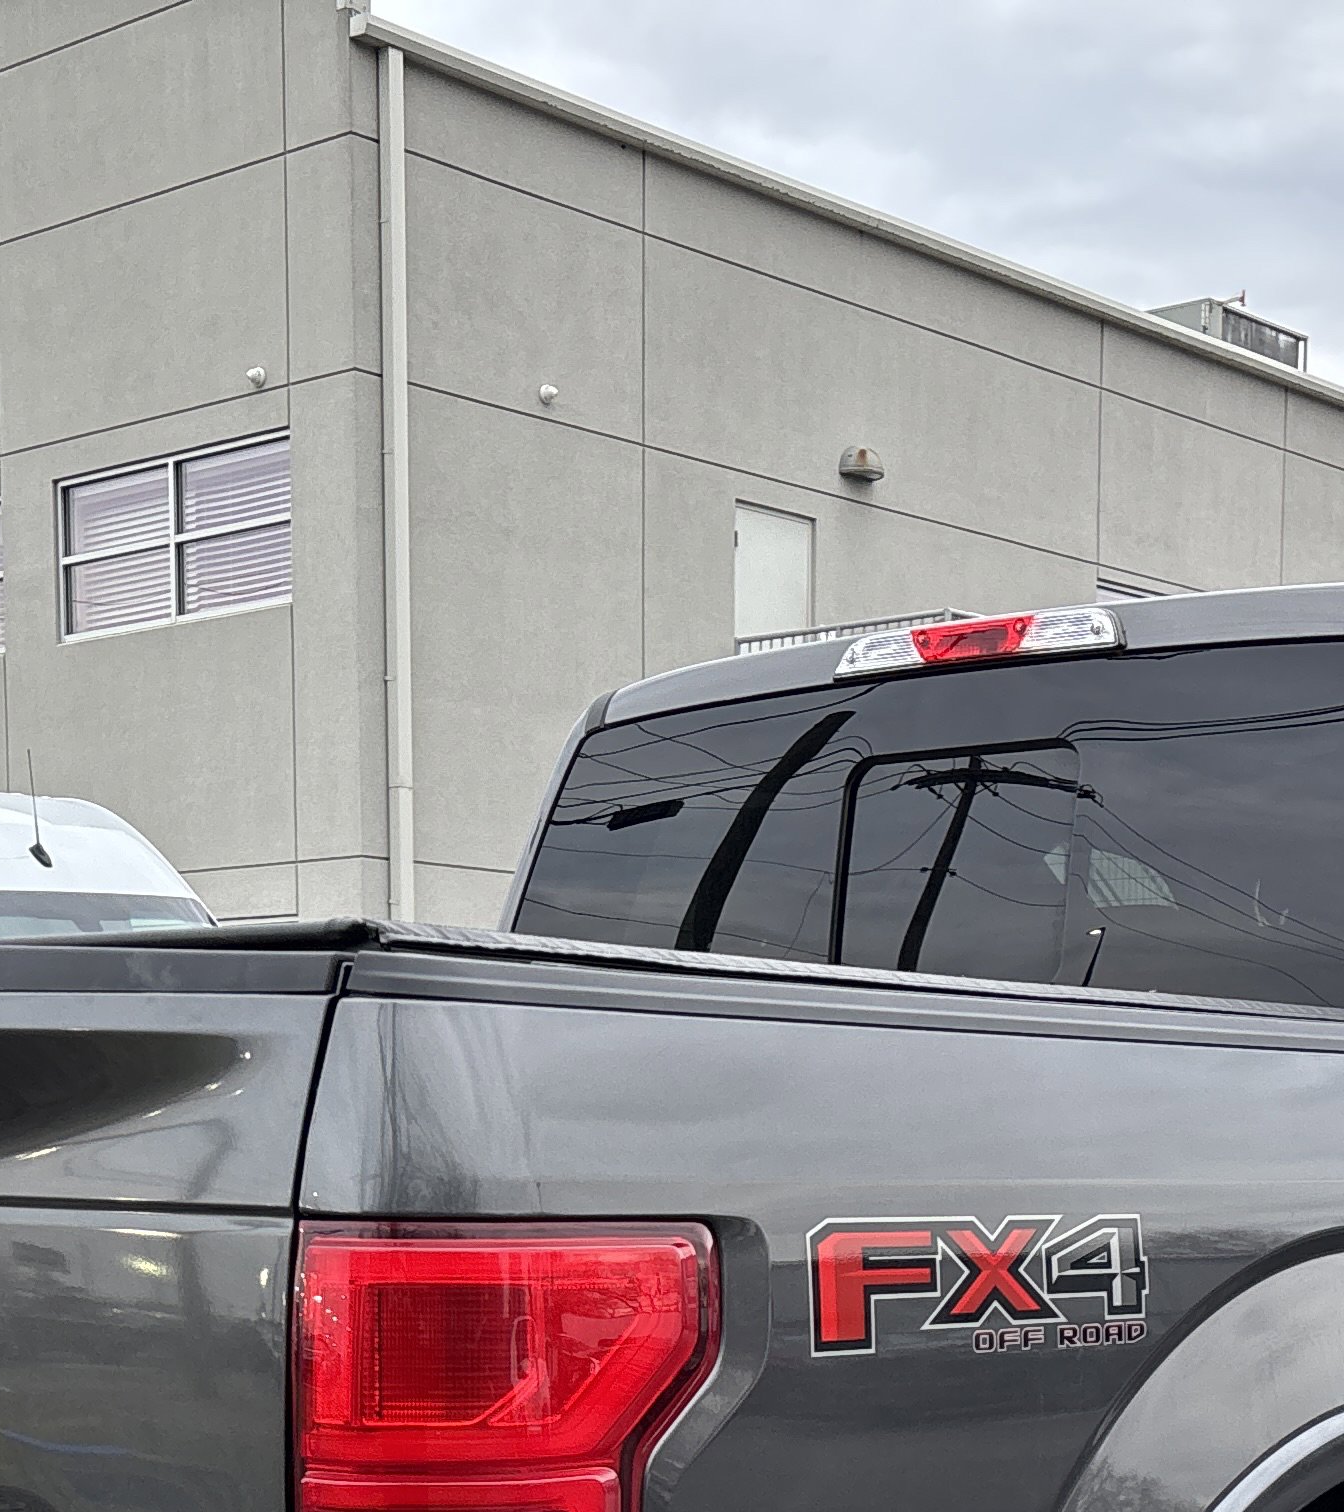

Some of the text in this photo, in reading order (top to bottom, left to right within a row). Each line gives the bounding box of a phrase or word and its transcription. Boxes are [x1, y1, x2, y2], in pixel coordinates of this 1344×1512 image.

[805, 1214, 1149, 1358] FX4
[973, 1320, 1148, 1354] OFF ROAD
